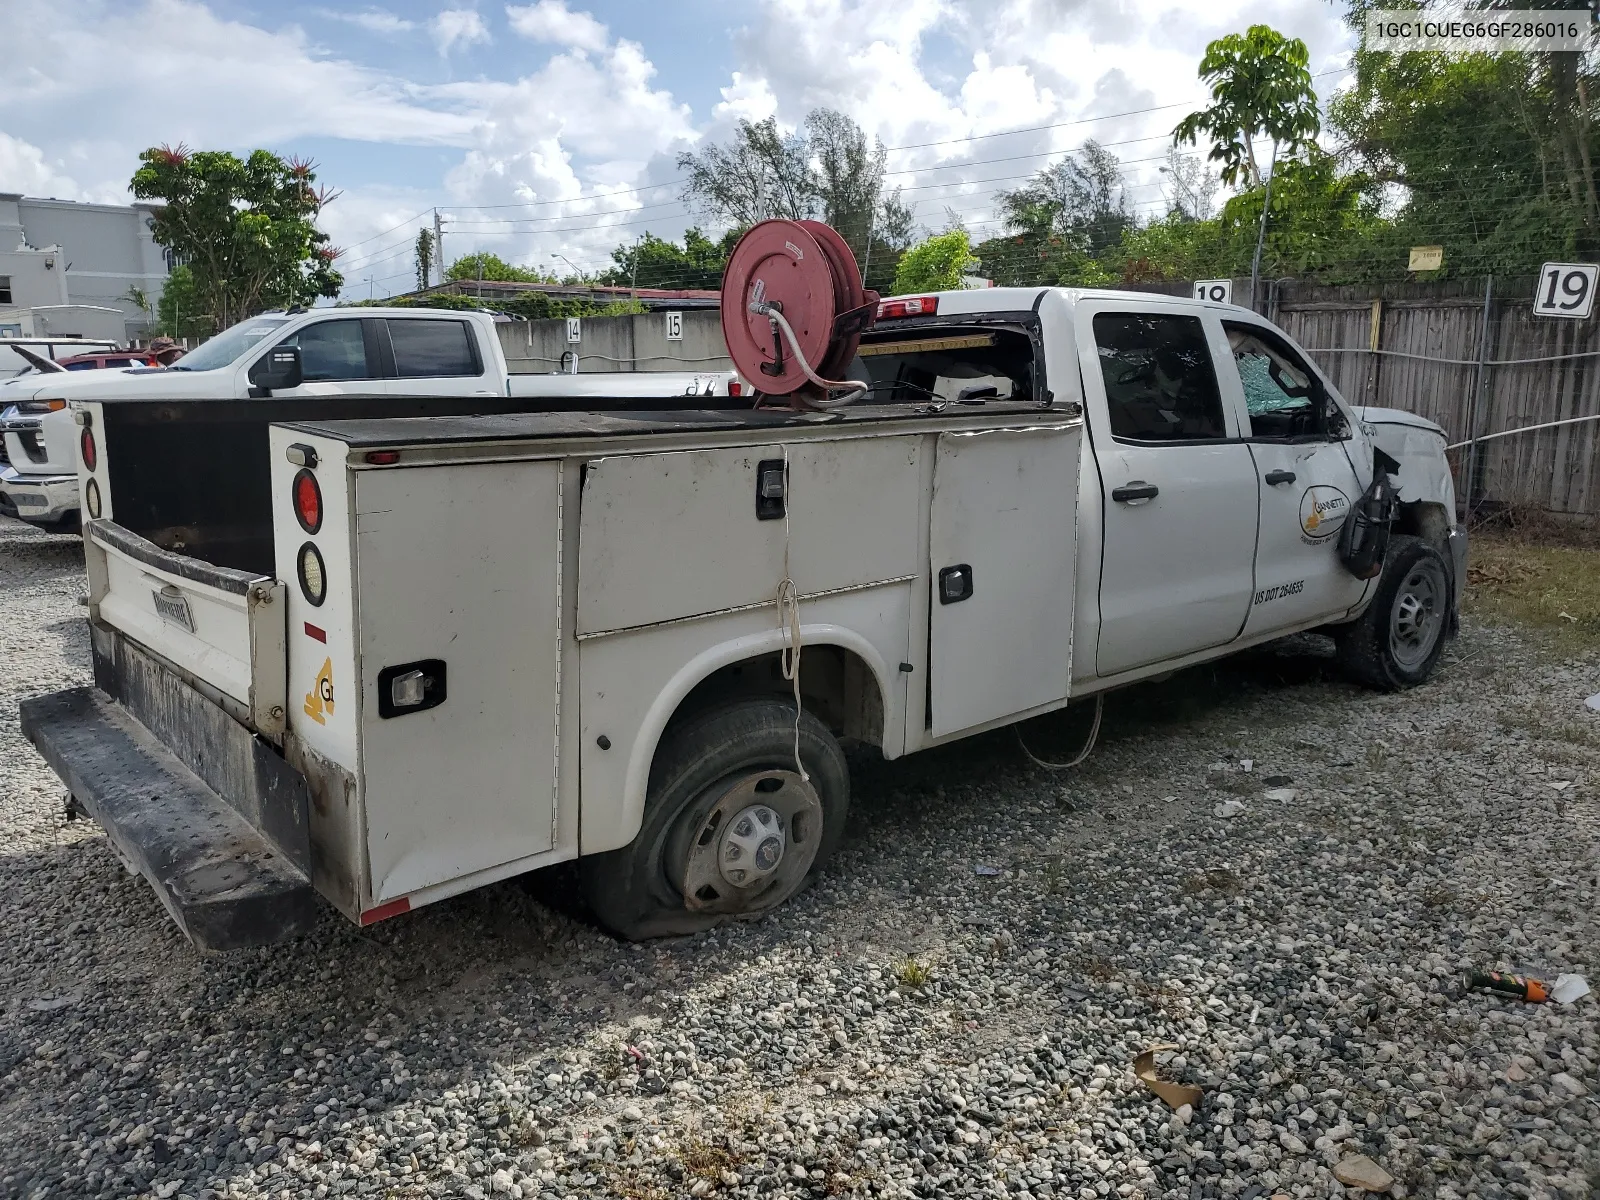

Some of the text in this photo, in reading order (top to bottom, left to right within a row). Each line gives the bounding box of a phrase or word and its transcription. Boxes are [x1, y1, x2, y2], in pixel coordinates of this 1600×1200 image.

[1541, 269, 1589, 311] 19
[568, 320, 579, 340] 14
[668, 315, 681, 337] 15
[1254, 580, 1305, 605] US DOT 264655
